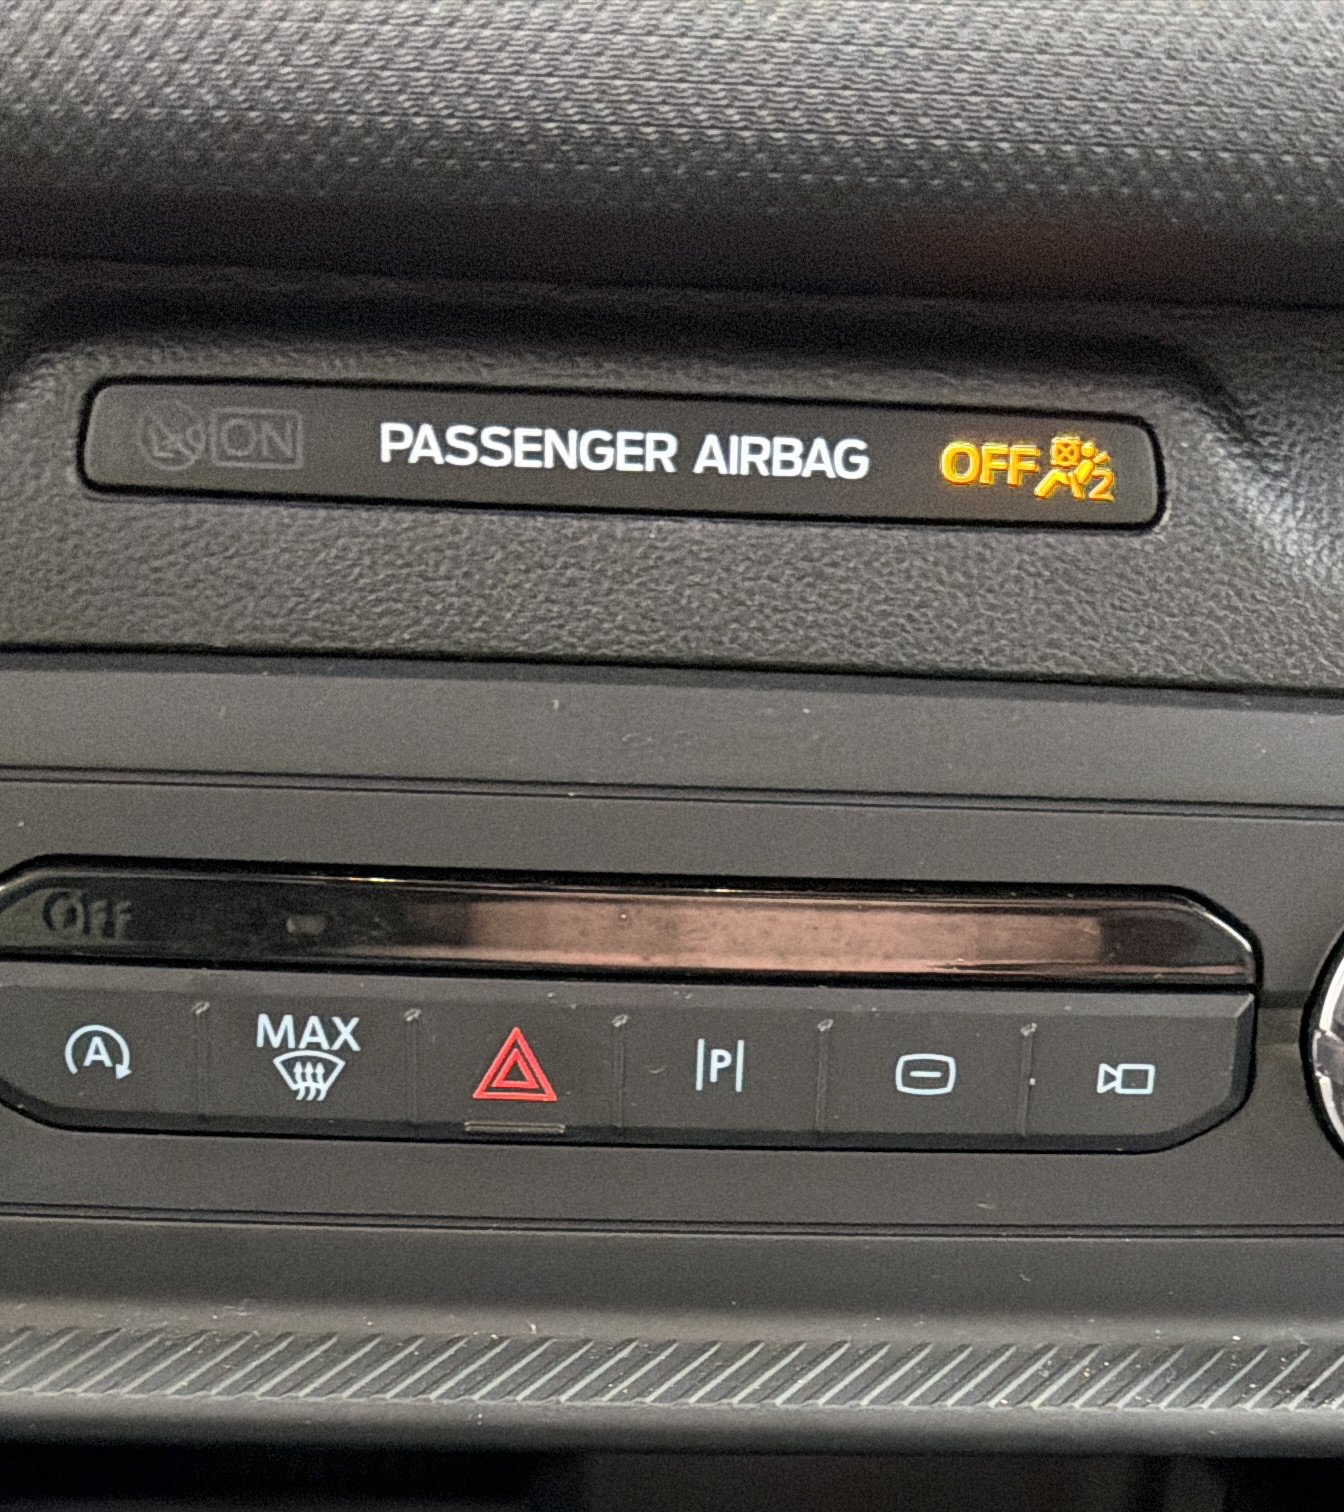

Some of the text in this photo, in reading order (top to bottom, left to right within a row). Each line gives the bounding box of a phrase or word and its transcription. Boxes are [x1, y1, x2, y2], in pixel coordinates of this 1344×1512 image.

[220, 417, 295, 459] ON
[379, 421, 871, 480] PASSENGER AIRBAG
[940, 440, 1041, 488] OFF
[82, 1036, 114, 1068] A
[256, 1012, 362, 1052] MAX
